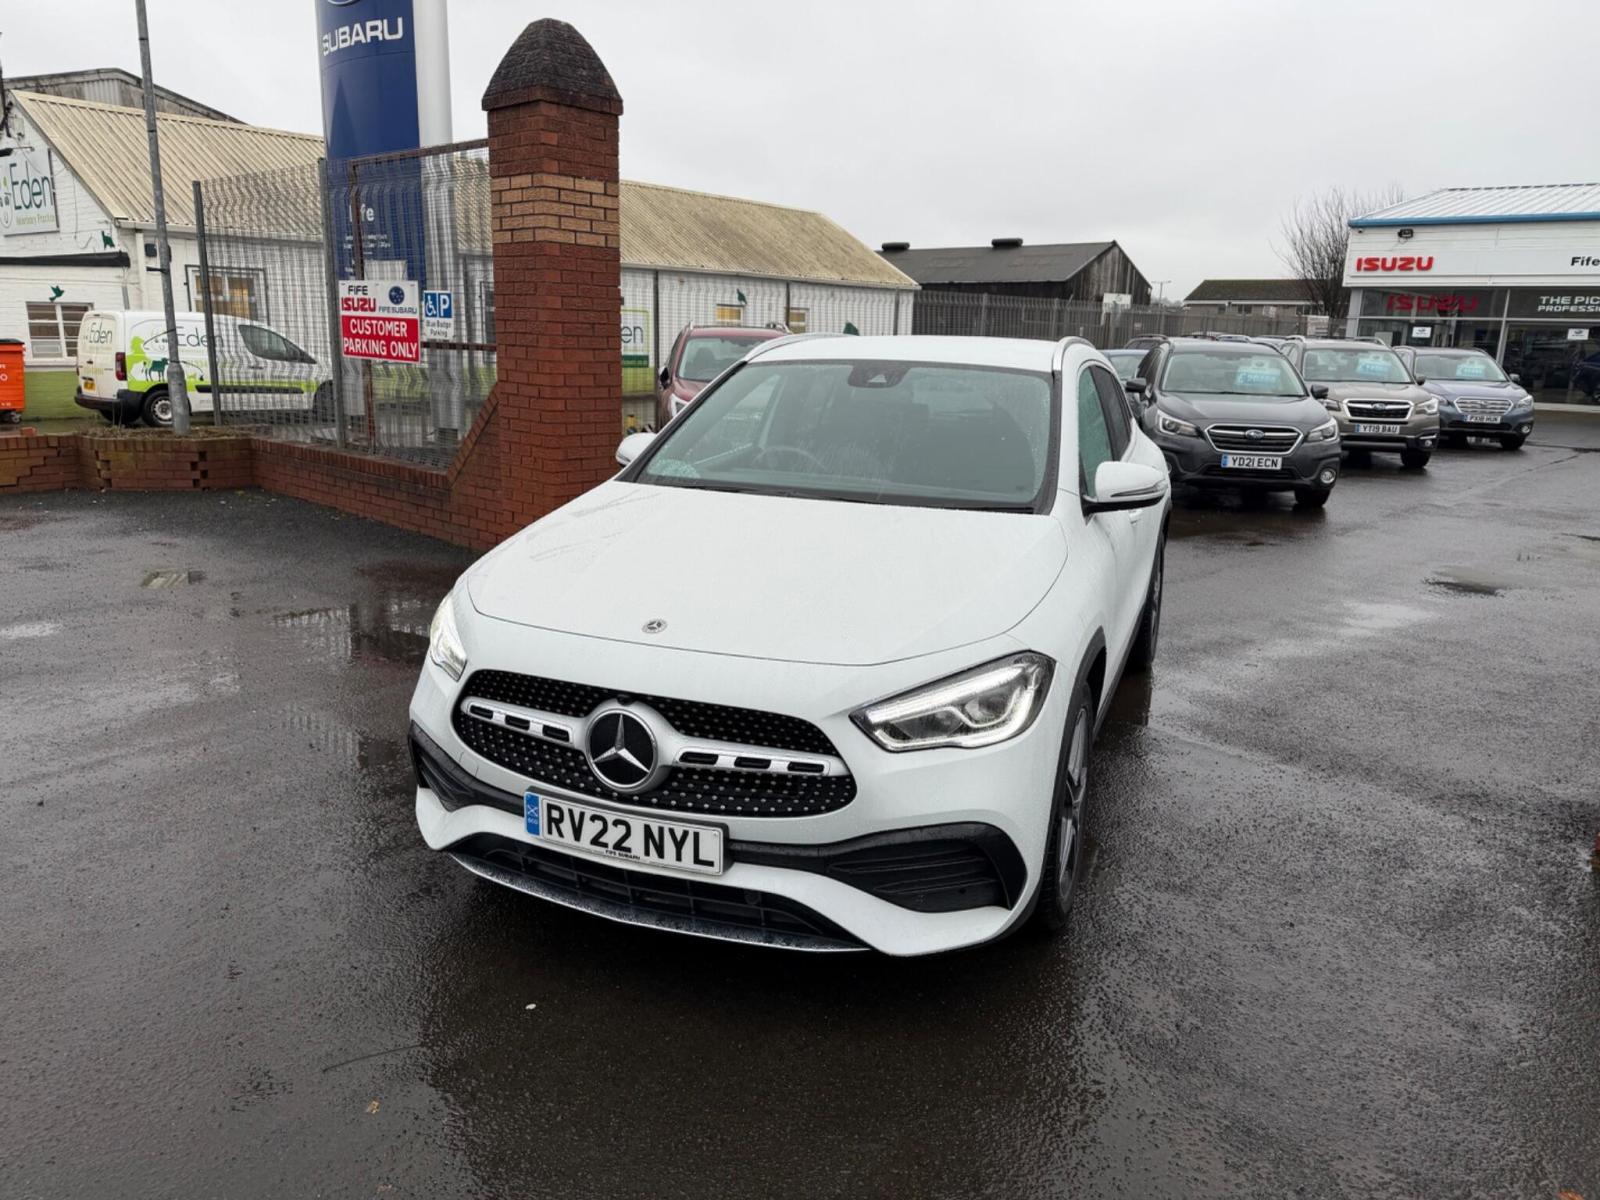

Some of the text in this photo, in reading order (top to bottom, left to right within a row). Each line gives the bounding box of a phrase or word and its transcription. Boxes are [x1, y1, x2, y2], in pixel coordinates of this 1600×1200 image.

[322, 16, 403, 56] SUBARU
[9, 160, 54, 210] Eden
[1356, 256, 1434, 272] ISUZU
[1571, 256, 1600, 266] Fife
[348, 285, 368, 295] FIFE
[341, 297, 376, 312] ISUZU
[440, 294, 450, 316] P
[1386, 294, 1478, 312] ISUZU
[1540, 296, 1571, 305] THE
[379, 306, 418, 315] FIFE SUBARU
[89, 322, 113, 344] Eden
[350, 318, 407, 337] CUSTOMER
[621, 326, 643, 344] en
[343, 337, 417, 358] PARKING ONLY
[1232, 457, 1278, 468] YD21 ECN
[546, 803, 715, 867] RV22 NYL
